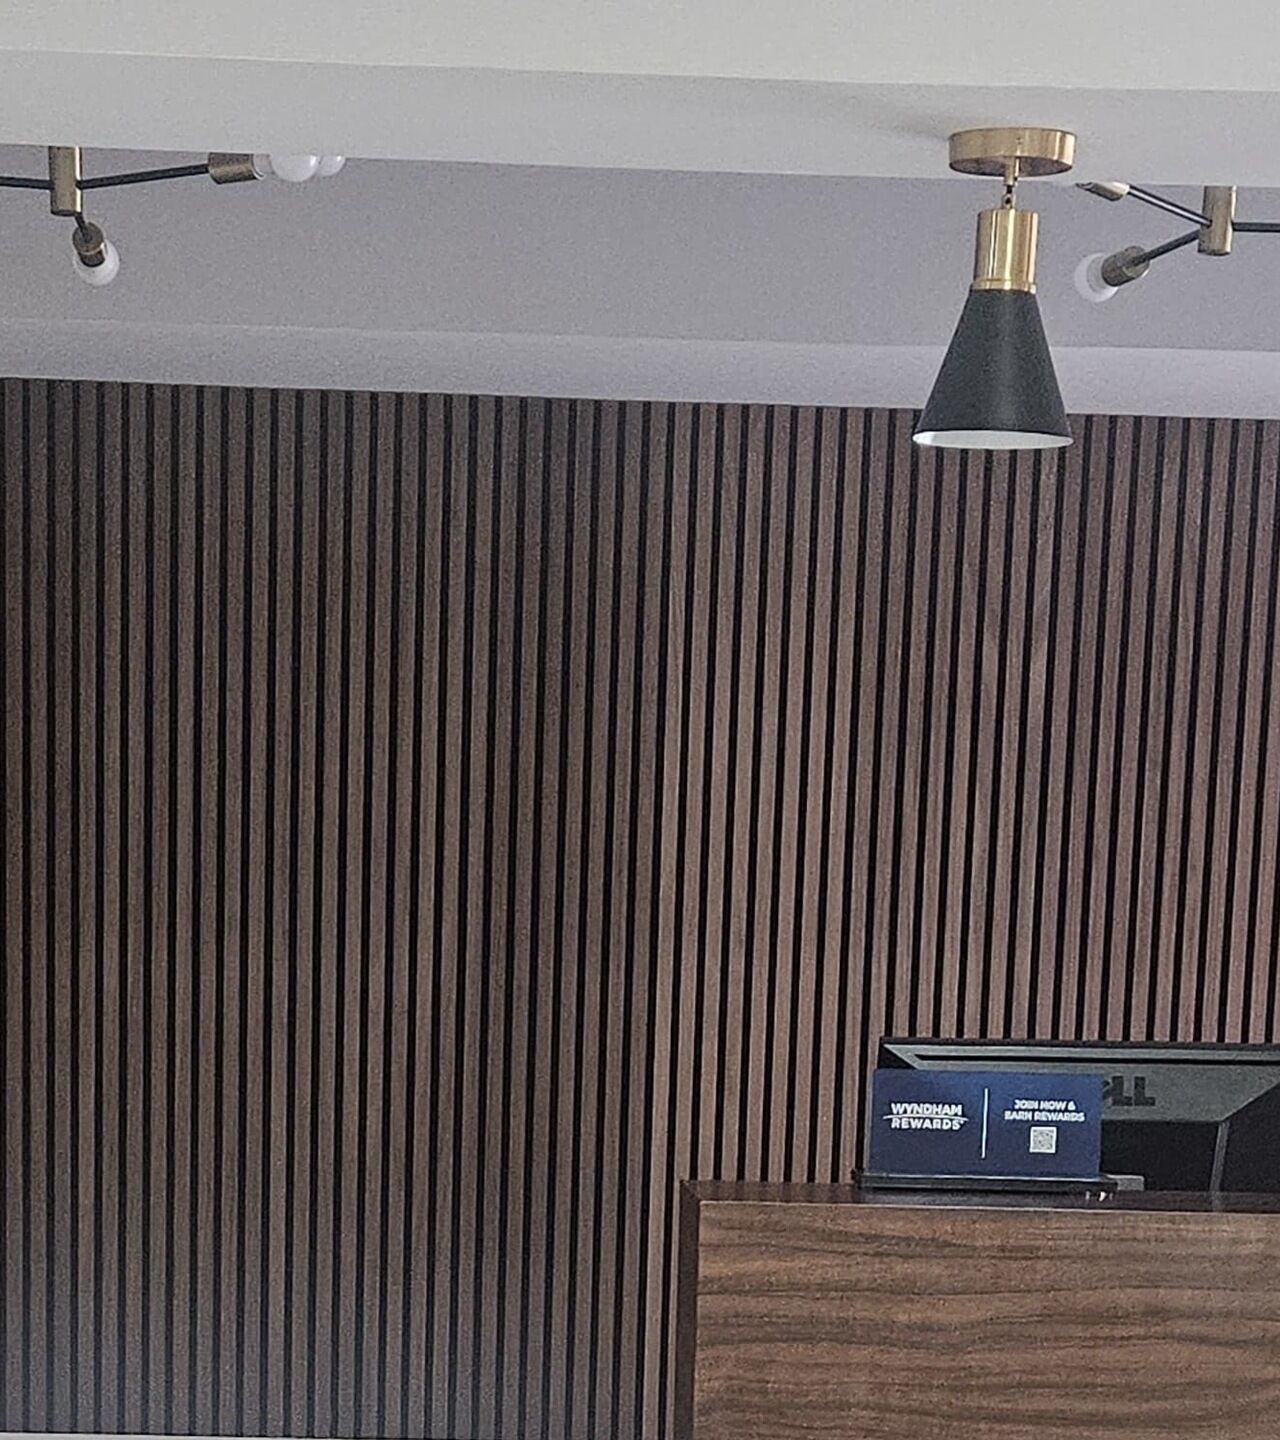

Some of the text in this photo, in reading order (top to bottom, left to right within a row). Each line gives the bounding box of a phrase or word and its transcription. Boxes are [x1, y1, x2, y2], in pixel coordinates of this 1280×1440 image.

[1103, 1075, 1156, 1107] LL
[890, 1103, 962, 1116] WYNDHAM
[1014, 1100, 1038, 1110] JOIN
[1040, 1101, 1065, 1111] NOW
[1004, 1111, 1085, 1122] EARN REWARDS
